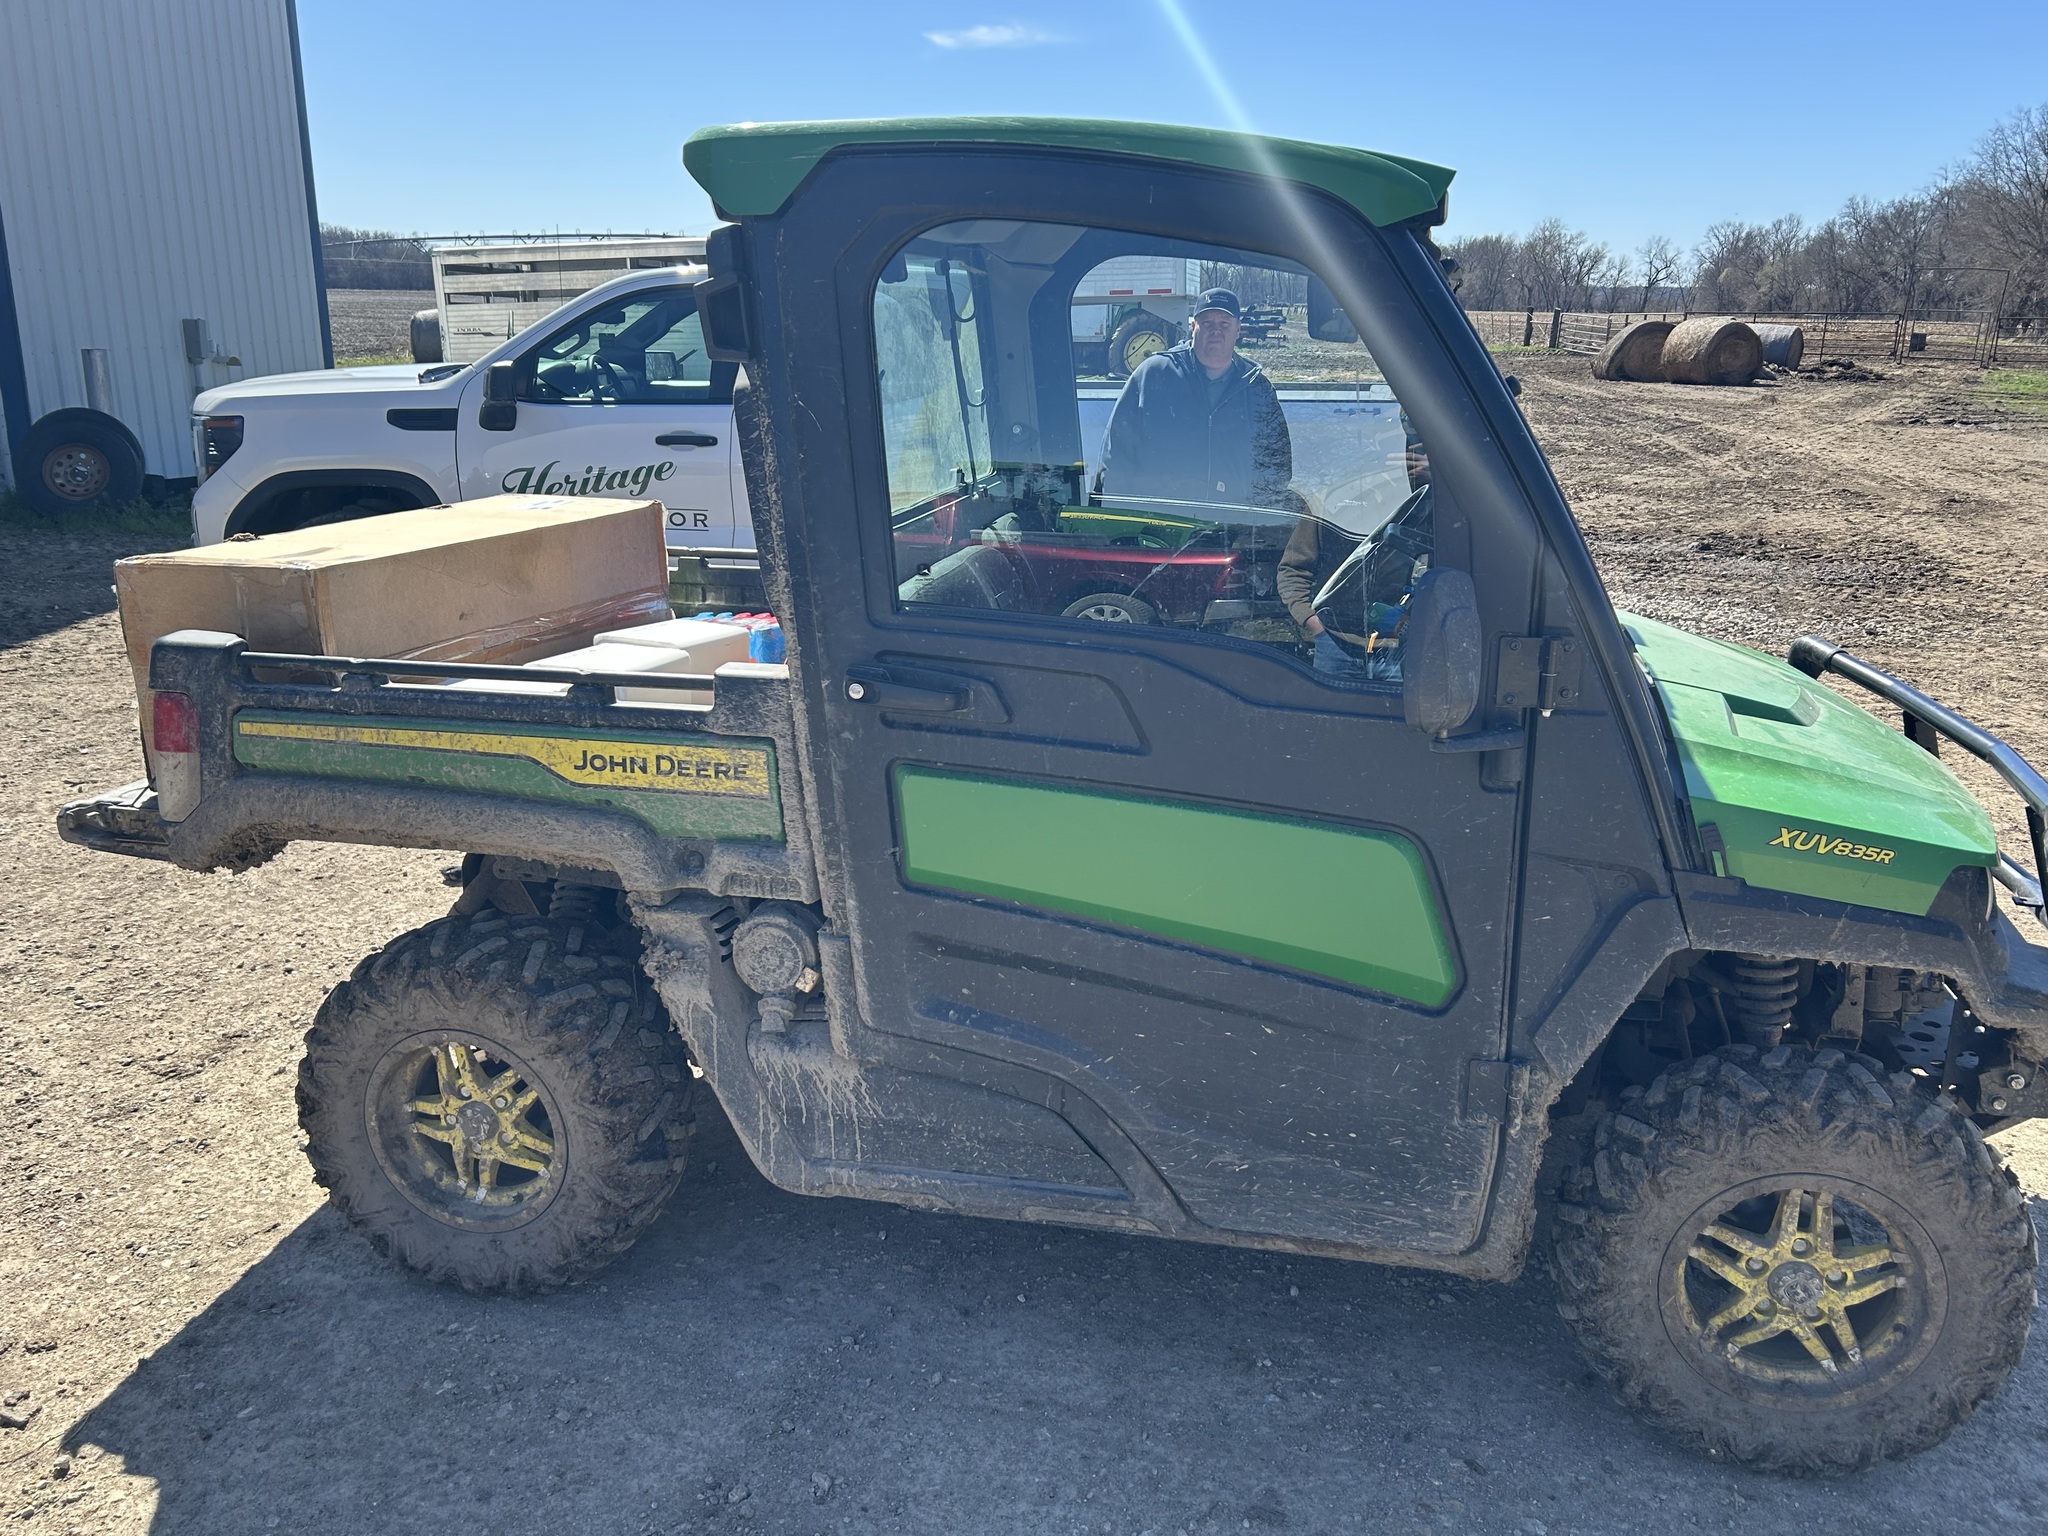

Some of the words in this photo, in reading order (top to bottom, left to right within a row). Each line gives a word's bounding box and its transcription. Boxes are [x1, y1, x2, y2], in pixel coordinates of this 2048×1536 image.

[502, 460, 677, 497] Heritage
[669, 512, 709, 528] OR
[573, 749, 647, 775] JOHN
[655, 754, 749, 781] DEERE
[1768, 827, 1897, 864] XUV835R
